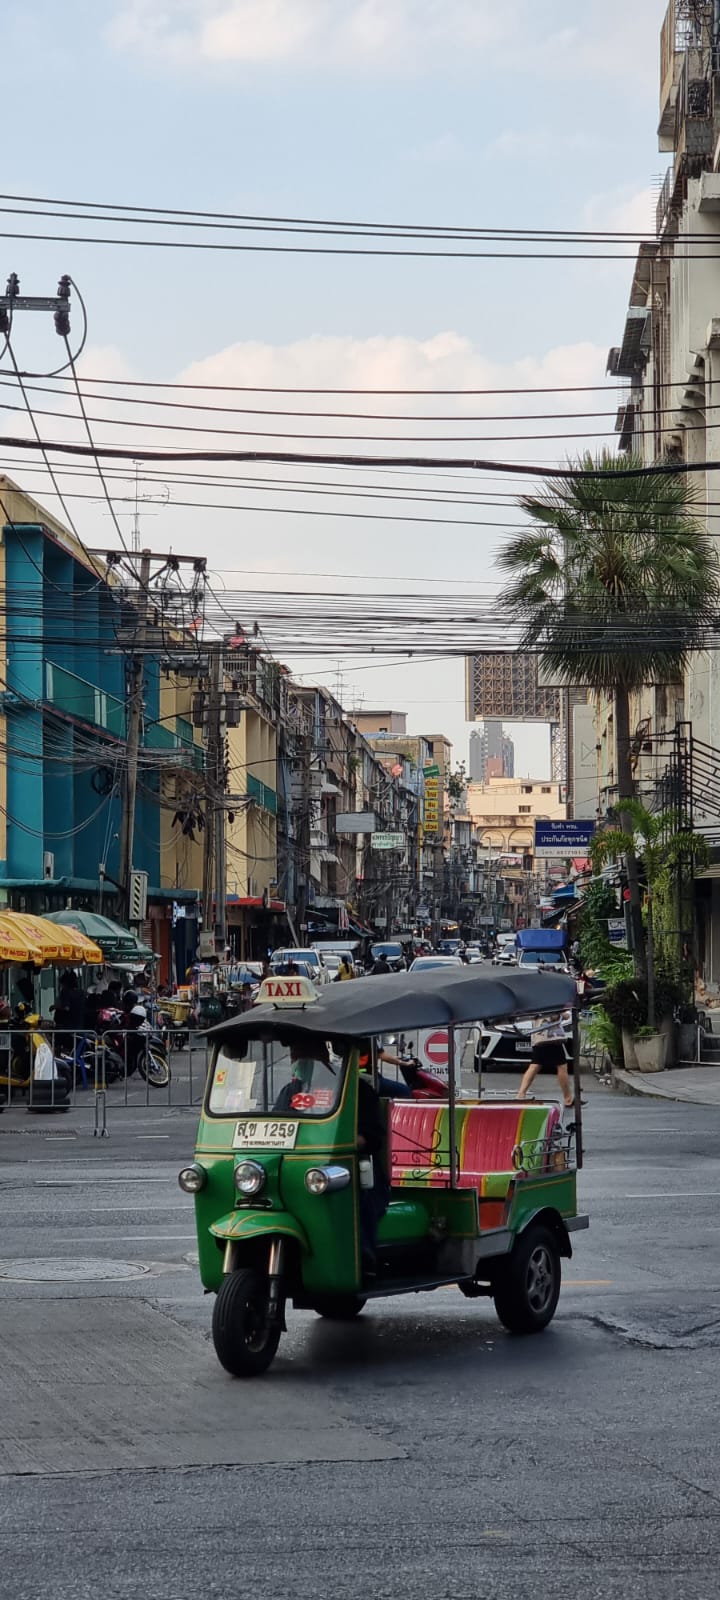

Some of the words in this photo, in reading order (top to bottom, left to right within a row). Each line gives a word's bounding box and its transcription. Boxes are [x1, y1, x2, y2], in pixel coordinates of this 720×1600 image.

[265, 982, 302, 997] TAXI
[292, 1094, 316, 1110] 29
[264, 1122, 296, 1137] 1259
